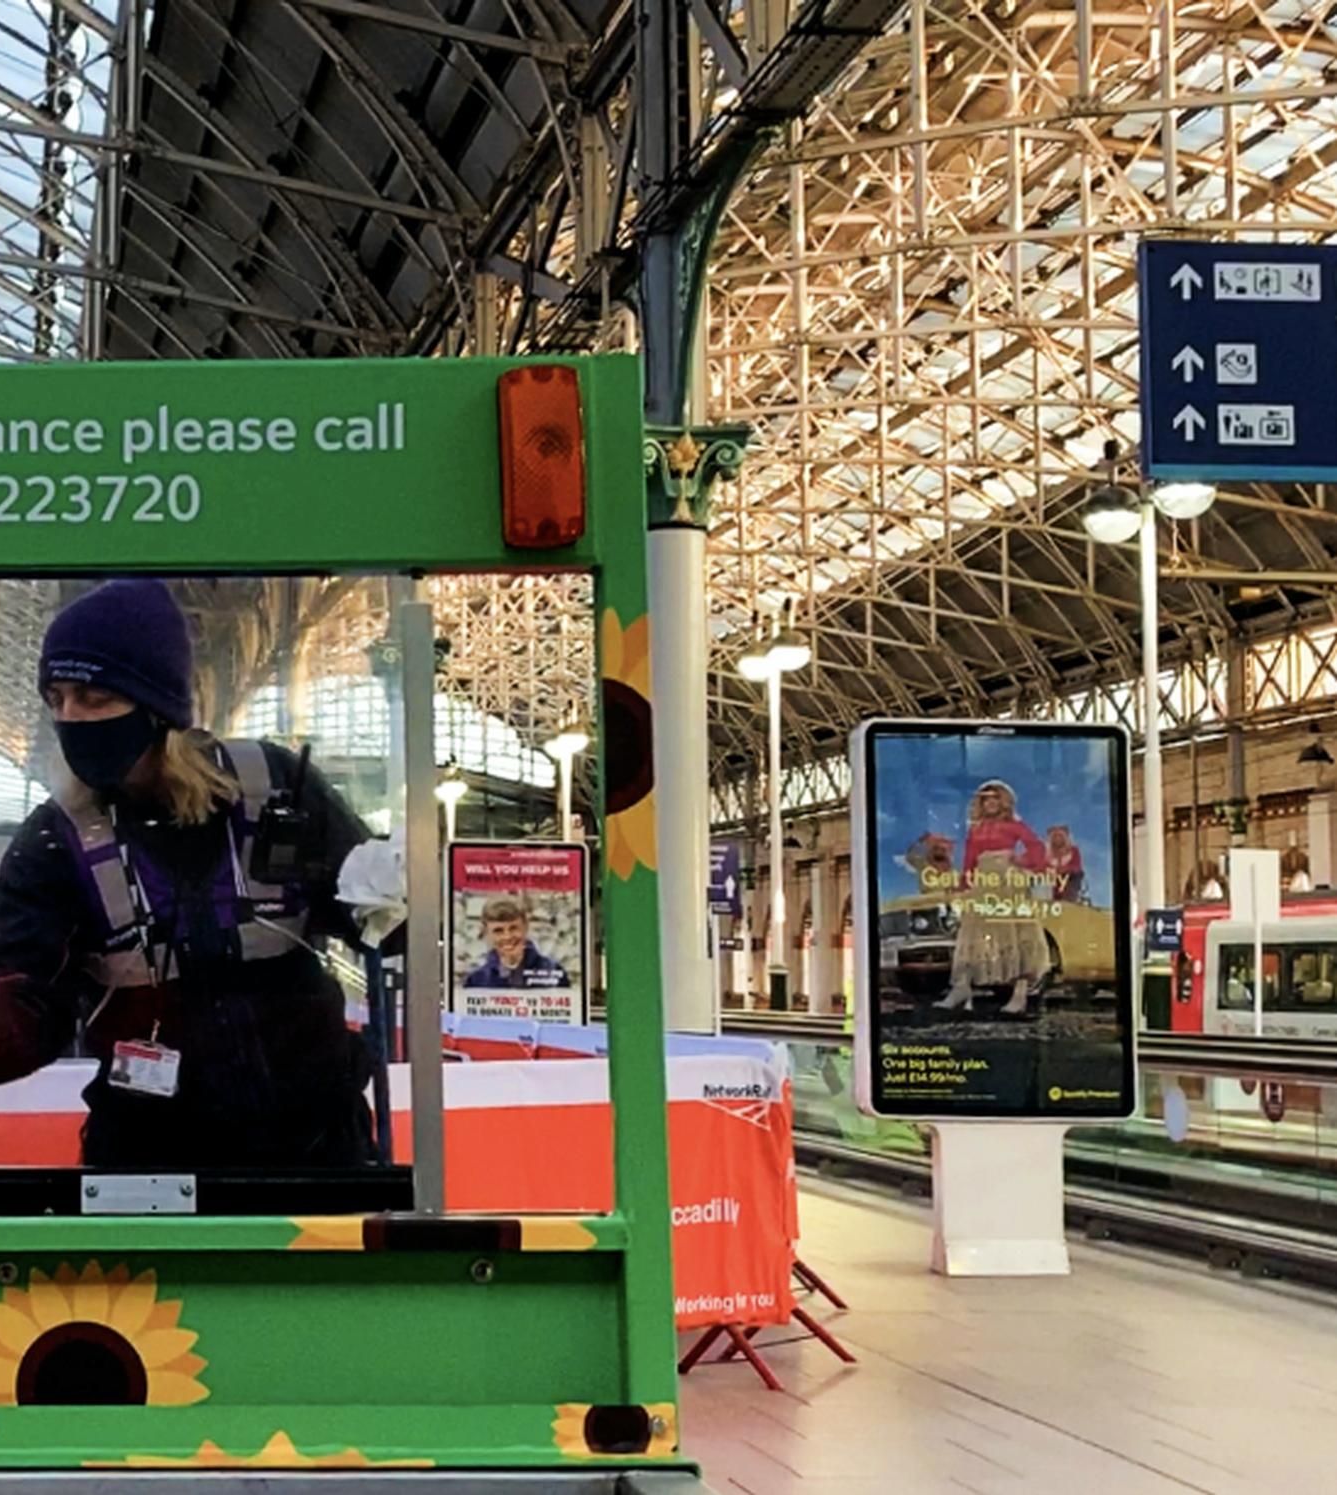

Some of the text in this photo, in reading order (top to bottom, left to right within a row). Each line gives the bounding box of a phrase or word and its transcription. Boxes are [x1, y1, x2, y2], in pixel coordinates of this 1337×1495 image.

[123, 404, 296, 464] please
[315, 402, 405, 452] call
[494, 864, 520, 874] YOU
[521, 864, 551, 875] HELP
[552, 865, 570, 876] US
[921, 865, 1070, 893] Get the family
[540, 1008, 571, 1017] MONTH
[882, 1057, 907, 1069] One
[703, 1084, 772, 1098] NetworkRl
